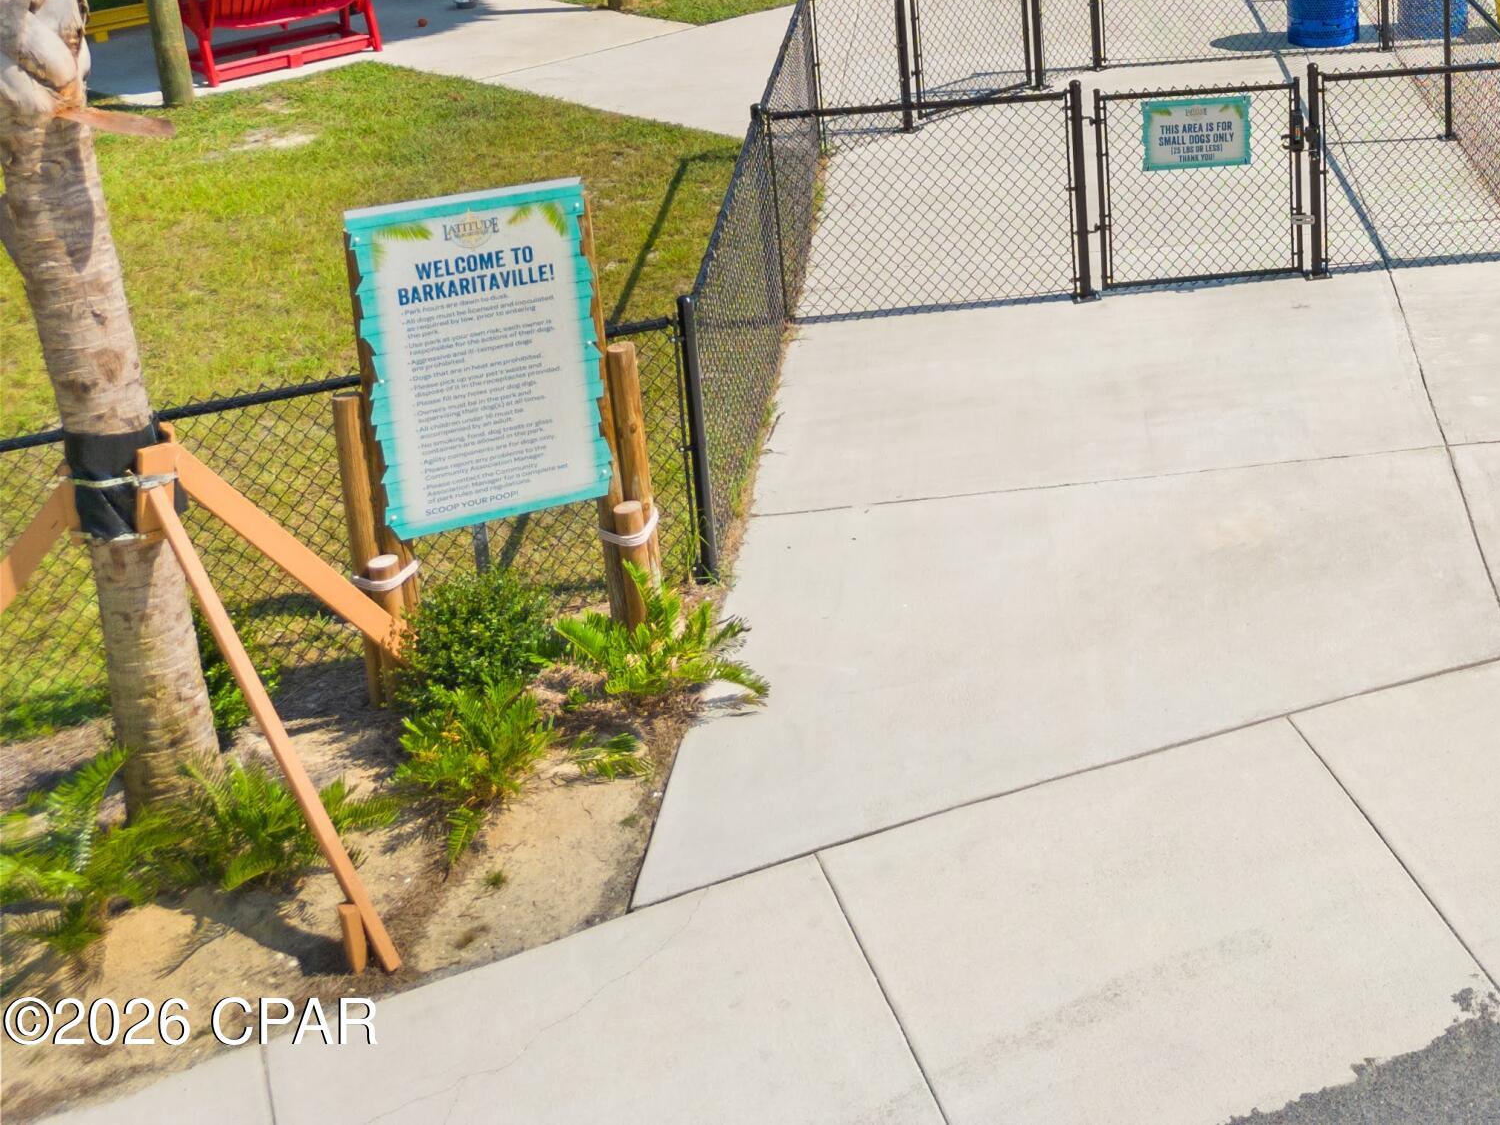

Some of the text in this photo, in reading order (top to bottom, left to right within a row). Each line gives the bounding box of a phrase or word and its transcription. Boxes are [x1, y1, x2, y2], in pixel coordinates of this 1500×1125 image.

[1159, 132, 1234, 147] SMALL DOGS ONLY
[1160, 121, 1232, 135] THIS AREA IS FOR
[415, 246, 534, 281] WELCOME TO
[397, 263, 555, 306] BARKARITAVILLE!
[425, 490, 519, 516] SCOOP YOUR POOP!
